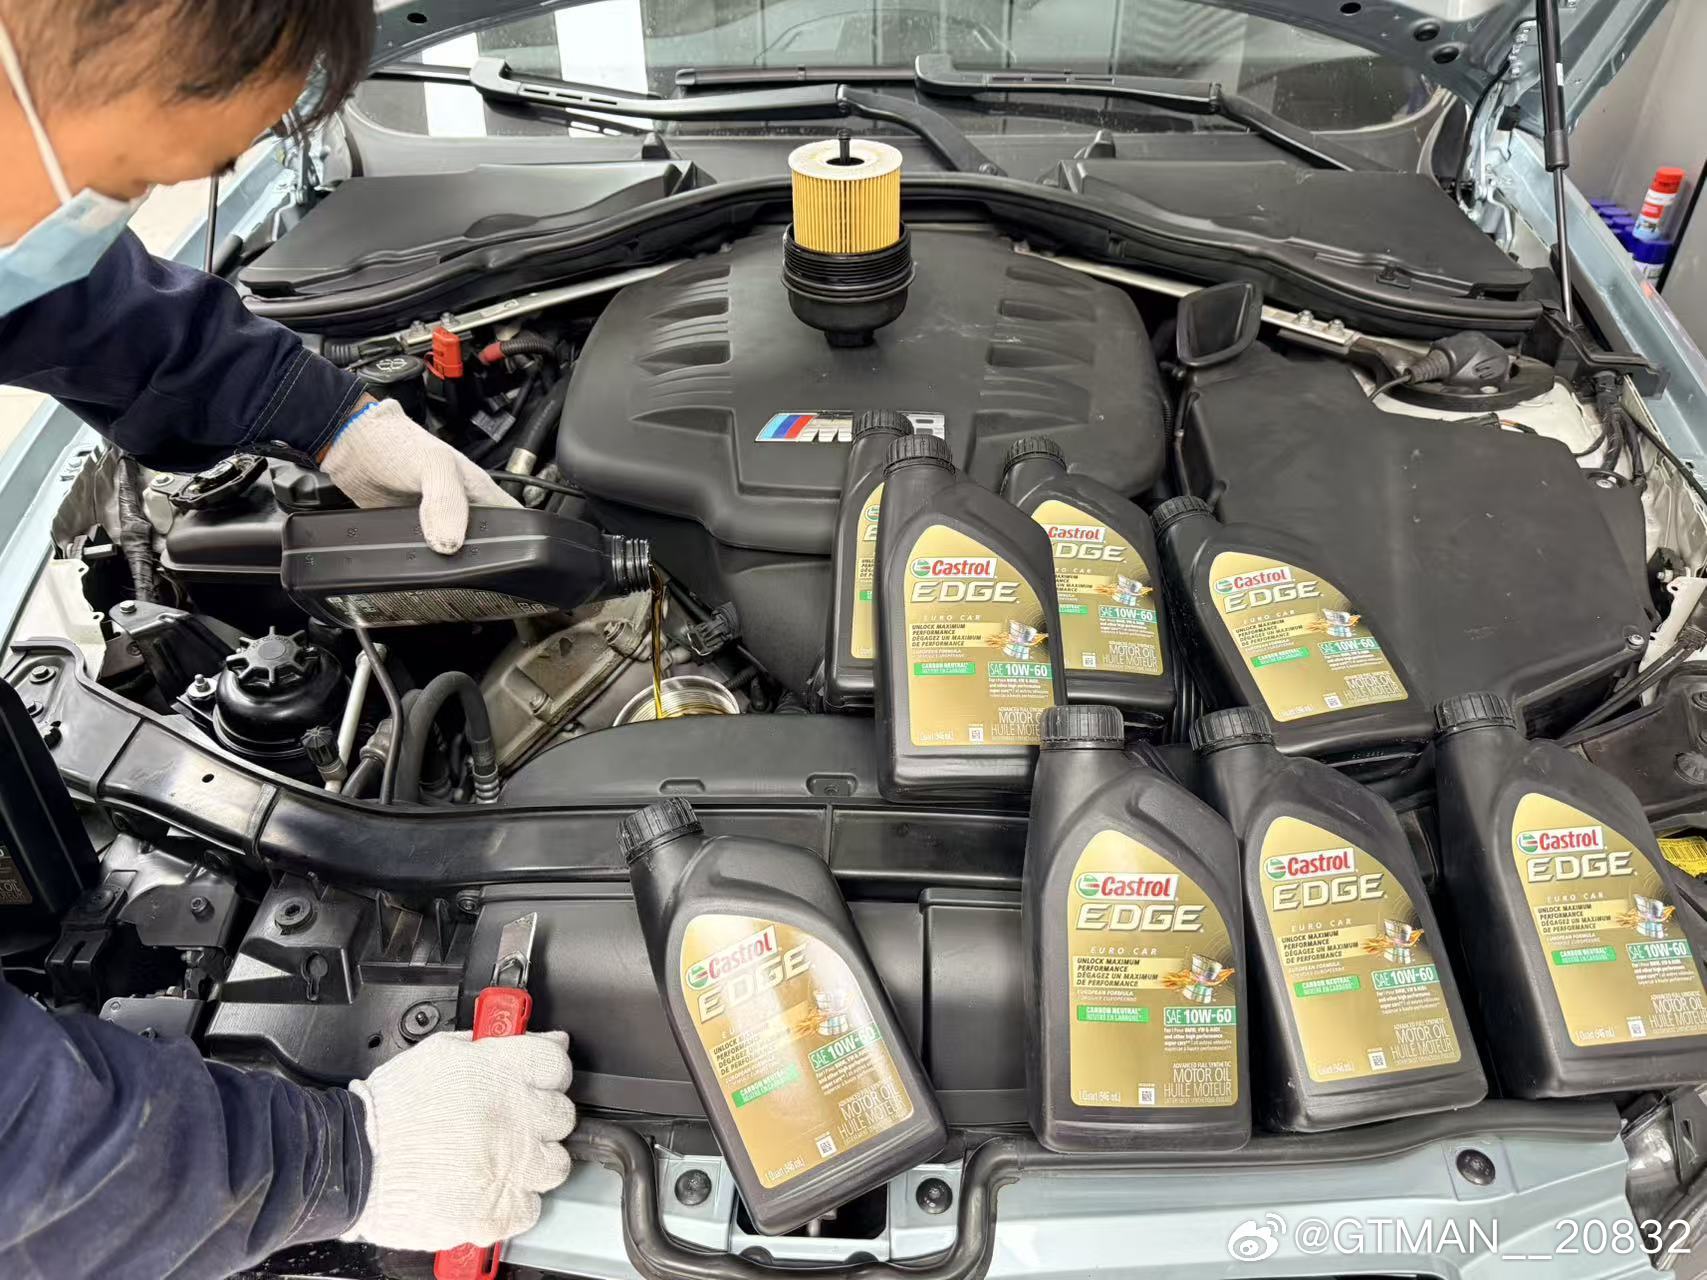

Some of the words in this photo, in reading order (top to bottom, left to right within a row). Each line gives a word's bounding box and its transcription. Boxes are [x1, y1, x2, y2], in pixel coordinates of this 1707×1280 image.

[1048, 526, 1101, 541] Castrol
[1053, 542, 1128, 562] DGE
[931, 559, 992, 577] Castrol
[1233, 567, 1288, 590] Castrol
[910, 581, 1021, 604] EDGE
[1223, 580, 1322, 614] EDGE
[1115, 607, 1153, 621] 10W-60
[1108, 644, 1140, 658] MOTOR
[1141, 647, 1156, 659] OIL
[1336, 638, 1375, 651] 10W-60
[989, 664, 1003, 676] SAE
[1006, 663, 1048, 677] 10W-60
[998, 711, 1034, 724] MOTOR
[991, 724, 1015, 737] HUILE
[1018, 723, 1041, 736] MOTE
[1538, 829, 1599, 853] Castrol
[1287, 851, 1351, 877] Castrol
[1526, 851, 1633, 883] EDGE
[1101, 875, 1171, 898] Castrol
[1272, 872, 1385, 912] EDGE
[1537, 906, 1562, 914] UNLOCK
[1562, 903, 1592, 911] MAXIMUM
[1540, 911, 1584, 920] PERFORMANCE
[1075, 902, 1207, 933] EDGE
[1291, 921, 1322, 933] EURO
[1329, 918, 1352, 927] CAR
[1552, 923, 1597, 932] PERFORMANCE
[1281, 934, 1307, 943] UNLOCK
[1307, 930, 1339, 939] MAXIMUM
[1283, 938, 1330, 950] PERFORMANCE
[1090, 946, 1125, 955] EURO
[1133, 947, 1158, 956] CAR
[1327, 941, 1359, 951] MAXIMUM
[1644, 941, 1688, 958] 10W-60
[708, 930, 774, 981] Castrol
[1076, 957, 1104, 965] UNLOCK
[1106, 958, 1140, 966] MAXIMUM
[1296, 951, 1342, 963] PERFORMANCE
[1076, 971, 1110, 979] DÉGAGEZ
[1077, 964, 1128, 973] PERFORMANCE
[1374, 972, 1391, 987] SAE
[1390, 966, 1435, 985] 10W-60
[697, 942, 813, 1025] EDGE
[1087, 979, 1139, 987] PERFORMANCE
[1651, 996, 1690, 1014] MOTOR
[1688, 996, 1705, 1011] OIL
[1165, 1009, 1181, 1024] SAE
[1183, 1008, 1232, 1024] 10W-60
[1648, 1014, 1675, 1029] HUILE
[1395, 1024, 1433, 1044] MOTOR
[1432, 1022, 1450, 1040] OIL
[713, 1038, 738, 1055] UNLOCK
[810, 1050, 828, 1068] SAE
[827, 1025, 877, 1060] 10W-60
[1390, 1042, 1418, 1060] HUILE
[1416, 1037, 1454, 1056] MOTEUR
[720, 1067, 729, 1076] DE
[1172, 1068, 1212, 1083] MOTOR
[1214, 1067, 1232, 1082] OIL
[1163, 1083, 1191, 1098] HUILE
[1193, 1082, 1232, 1097] MOTEUR
[840, 1089, 882, 1121] MOTOR
[879, 1080, 900, 1100] OIL
[837, 1115, 867, 1140] HUILE
